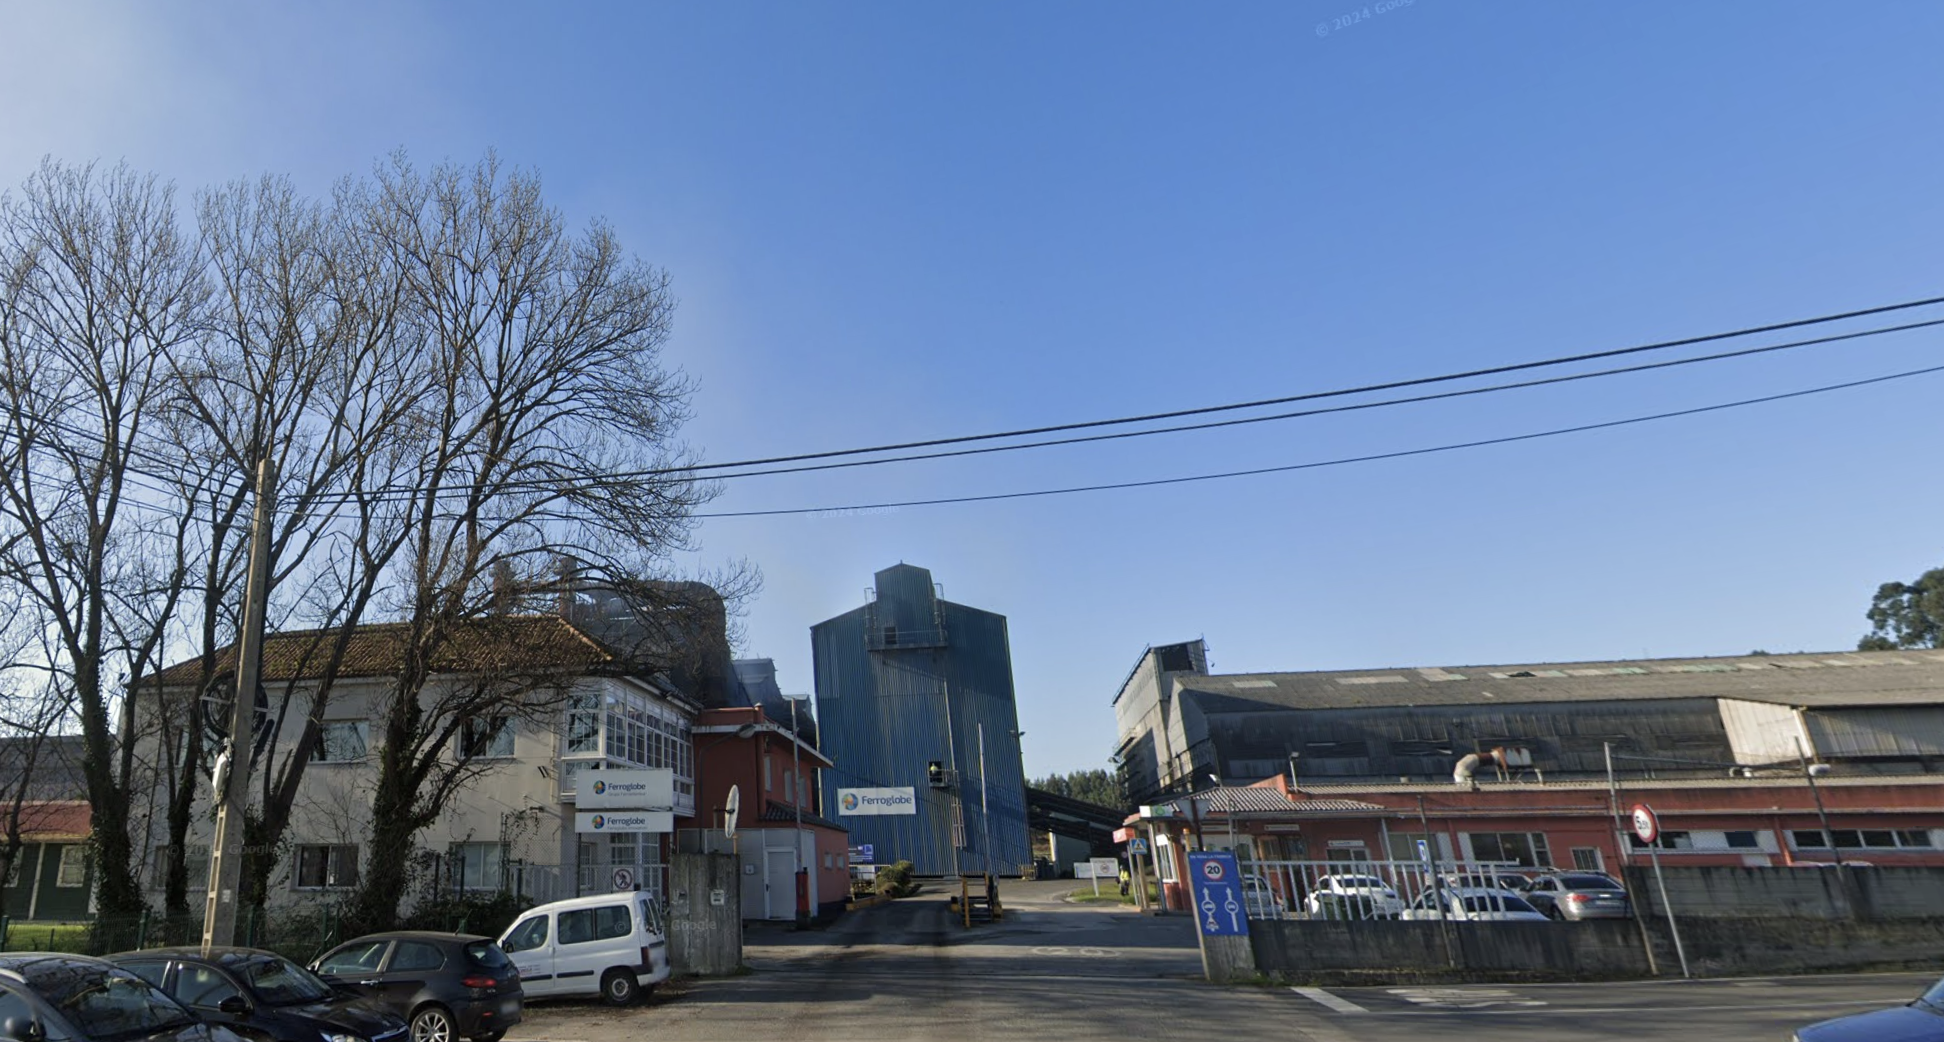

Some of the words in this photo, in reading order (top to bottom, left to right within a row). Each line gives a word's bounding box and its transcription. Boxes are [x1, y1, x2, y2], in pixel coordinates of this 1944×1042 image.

[608, 782, 646, 792] Ferroglobe
[862, 796, 912, 806] Ferroglobe
[607, 817, 646, 826] Ferroglobe
[1206, 865, 1221, 875] 20
